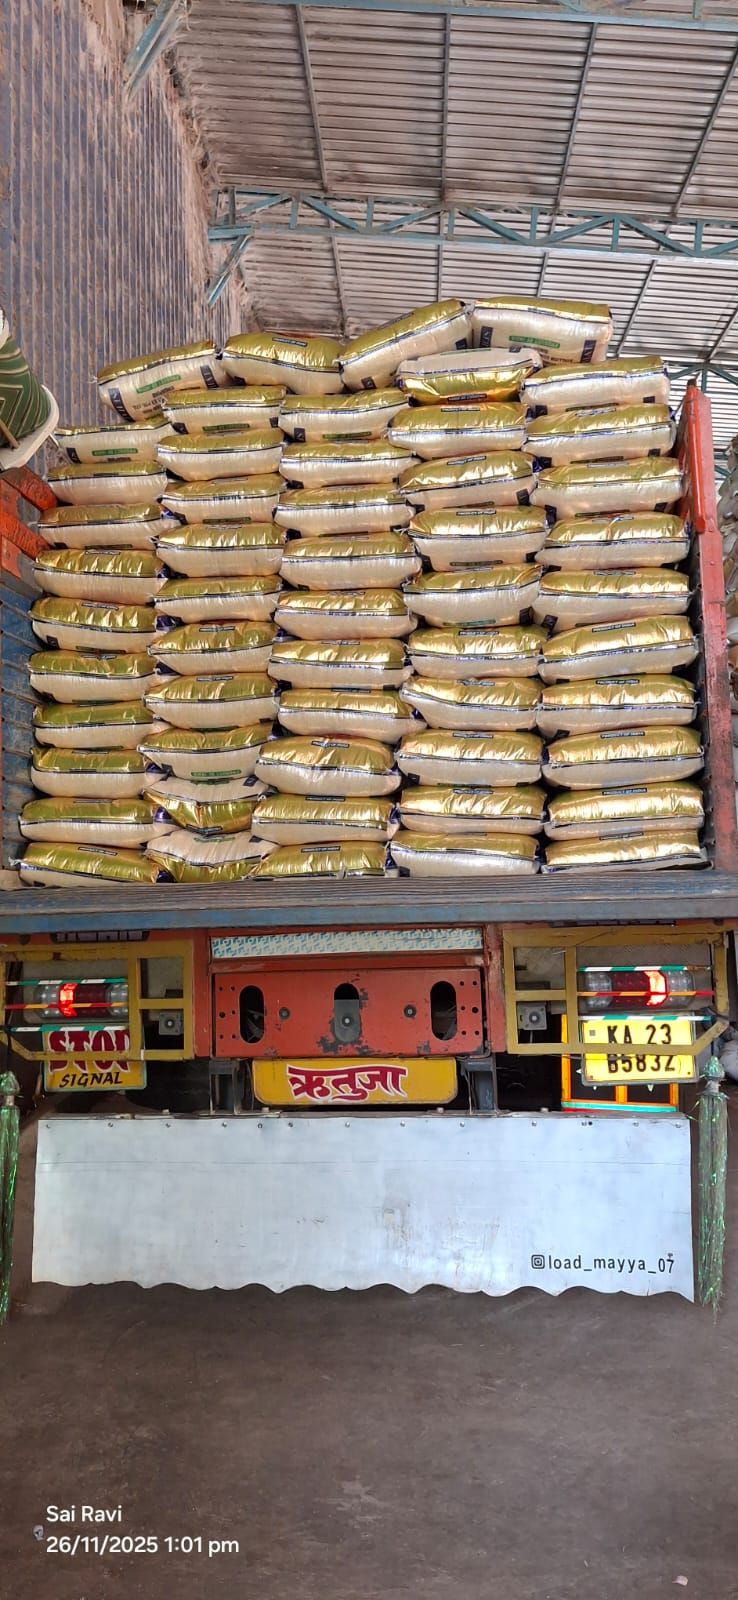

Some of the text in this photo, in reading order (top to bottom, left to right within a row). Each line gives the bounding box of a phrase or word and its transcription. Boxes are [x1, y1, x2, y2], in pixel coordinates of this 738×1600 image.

[607, 1023, 672, 1045] KA 23
[59, 1072, 123, 1088] SIGNAL
[287, 1064, 408, 1102] ऋतुजा
